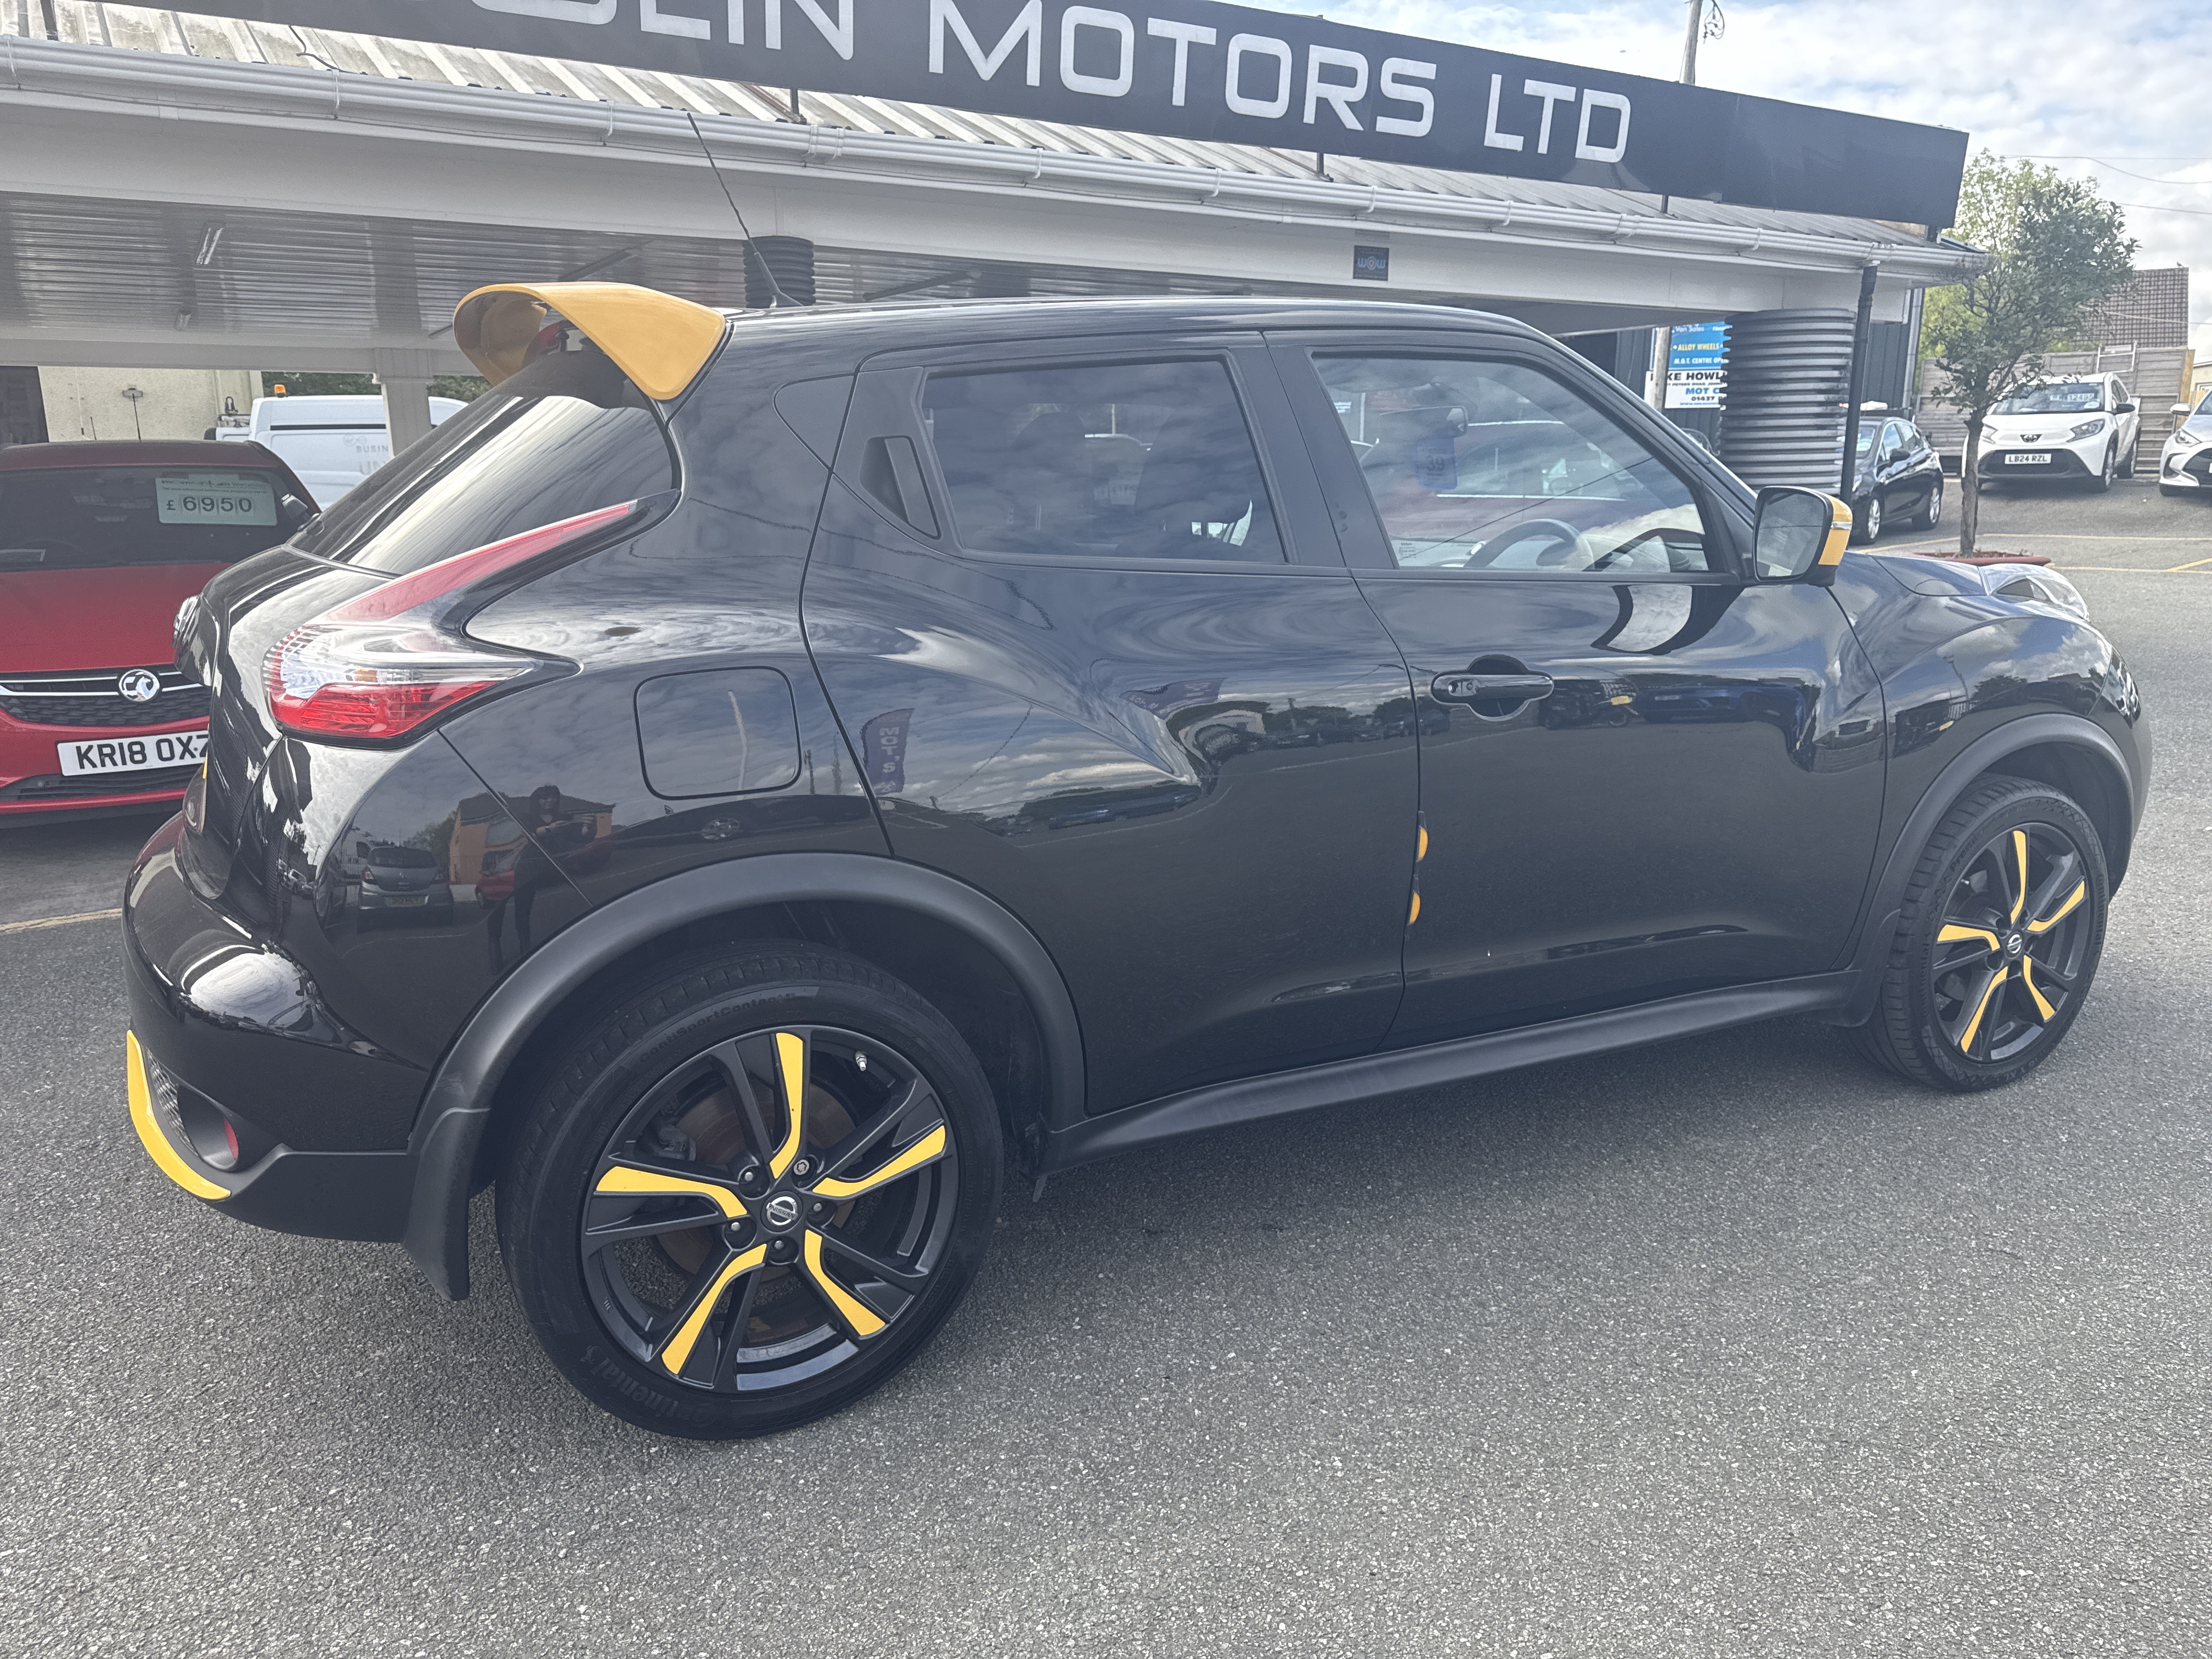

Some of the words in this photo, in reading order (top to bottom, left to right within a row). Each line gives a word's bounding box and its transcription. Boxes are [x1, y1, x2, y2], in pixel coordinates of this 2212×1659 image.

[929, 0, 1437, 137] MOTORS
[1483, 74, 1631, 163] LTD
[166, 500, 176, 511] £
[183, 496, 252, 512] 6950
[76, 741, 147, 769] KR18
[772, 1206, 795, 1218] NISSAN
